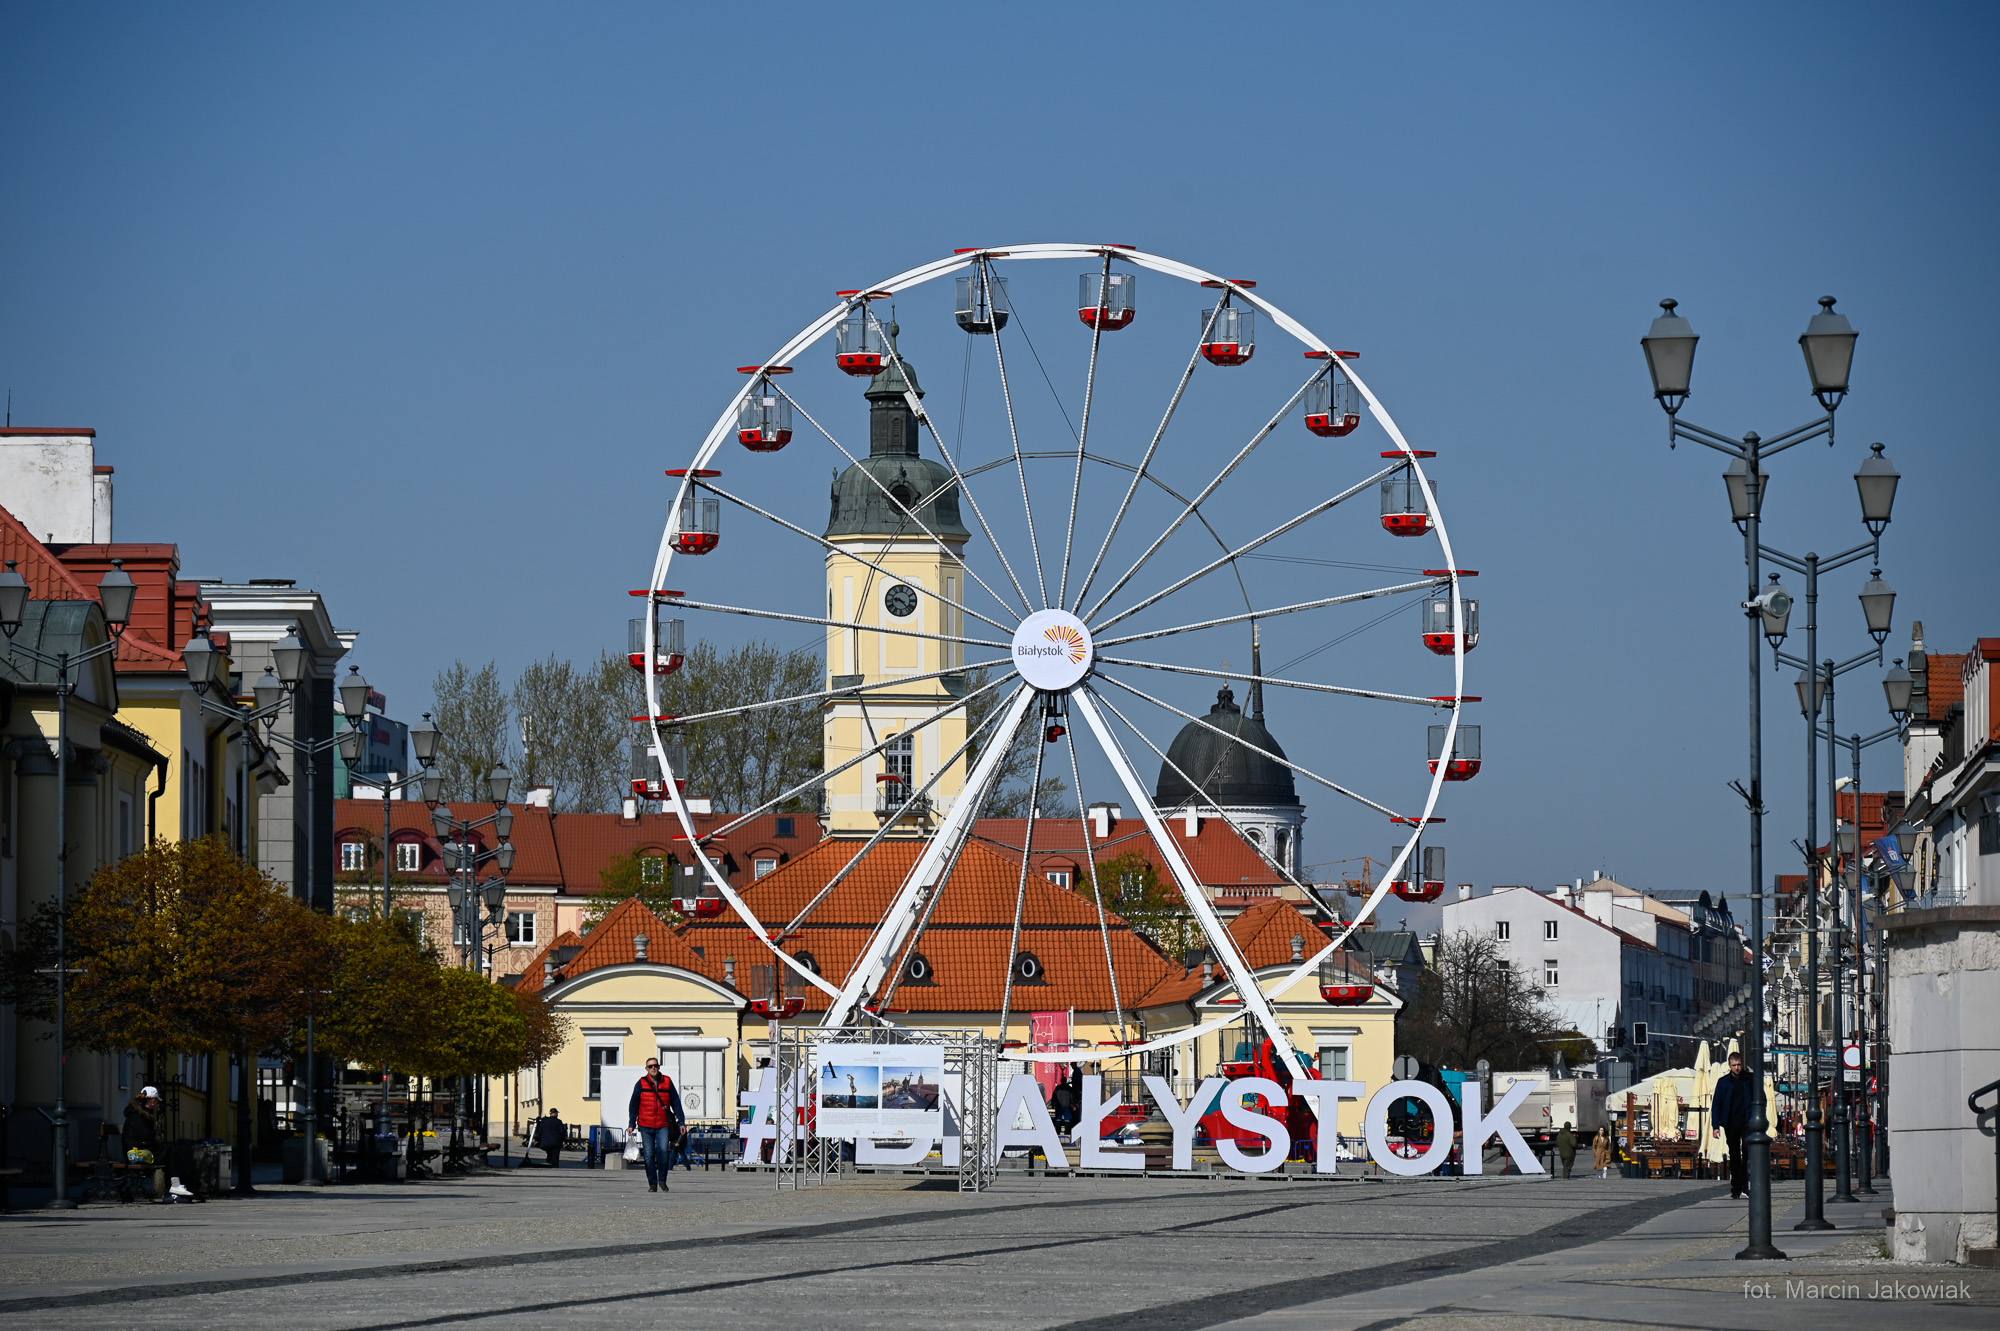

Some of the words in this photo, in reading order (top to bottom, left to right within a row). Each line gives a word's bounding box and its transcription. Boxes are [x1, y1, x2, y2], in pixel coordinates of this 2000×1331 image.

[1018, 645, 1063, 658] Białystok
[821, 1060, 838, 1079] A
[740, 1067, 1546, 1177] #AŁYSTOK
